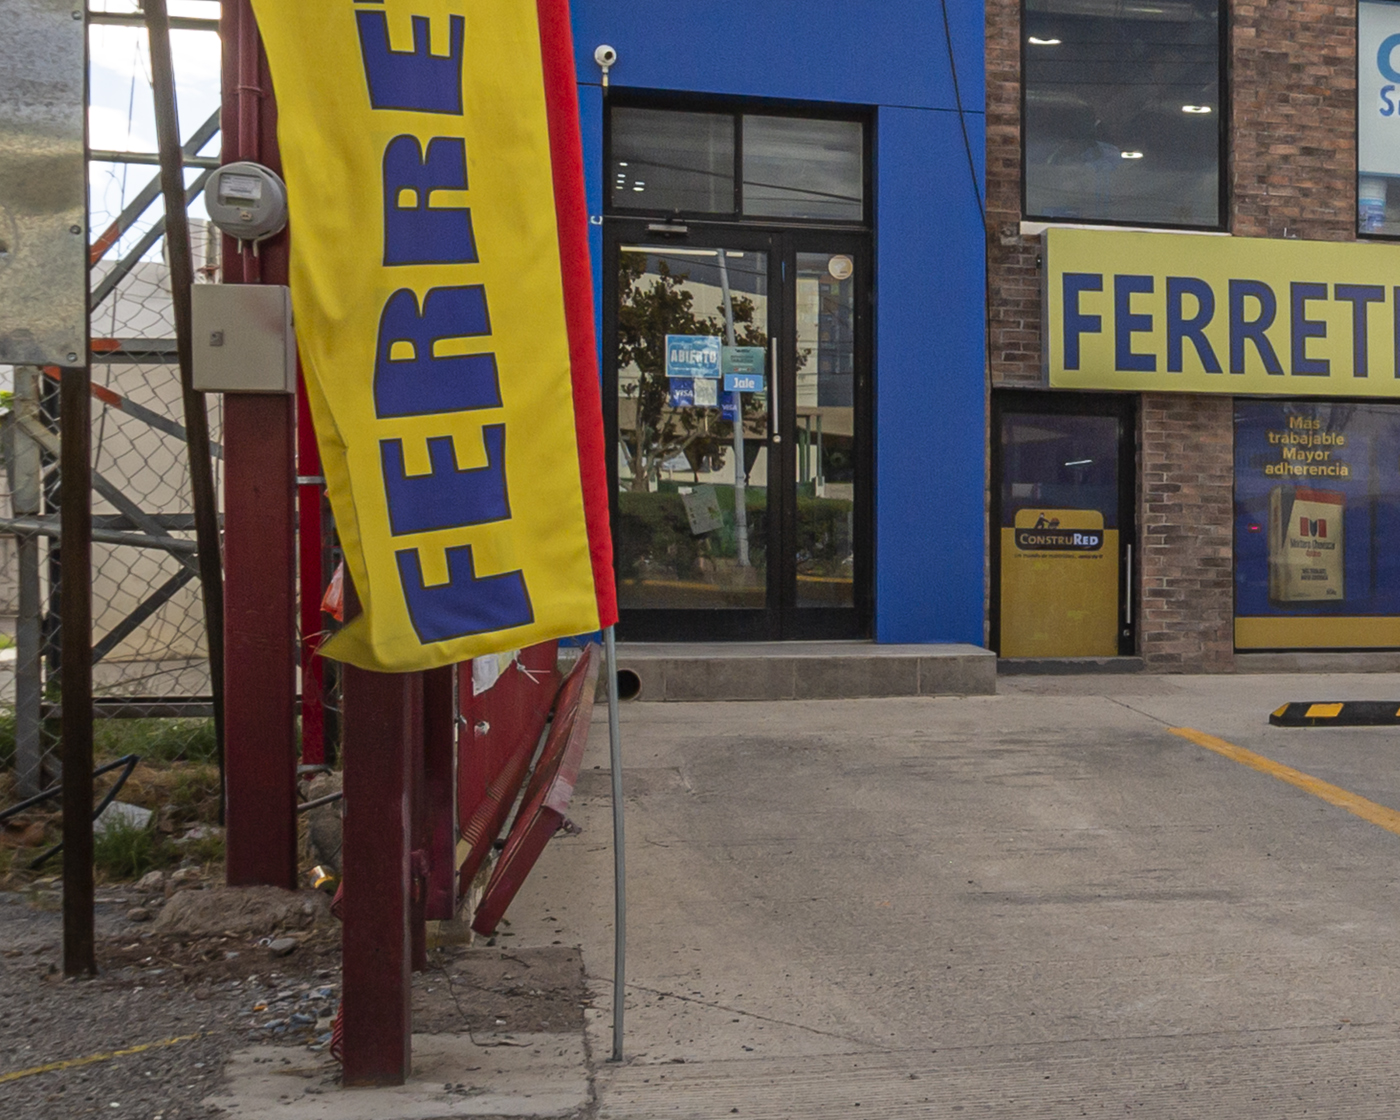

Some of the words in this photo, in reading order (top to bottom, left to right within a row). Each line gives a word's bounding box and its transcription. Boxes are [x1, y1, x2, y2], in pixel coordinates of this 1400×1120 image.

[733, 378, 755, 389] Jale
[1269, 433, 1345, 447] trabajable
[1283, 448, 1330, 462] Mayor
[1265, 462, 1348, 476] adherencia
